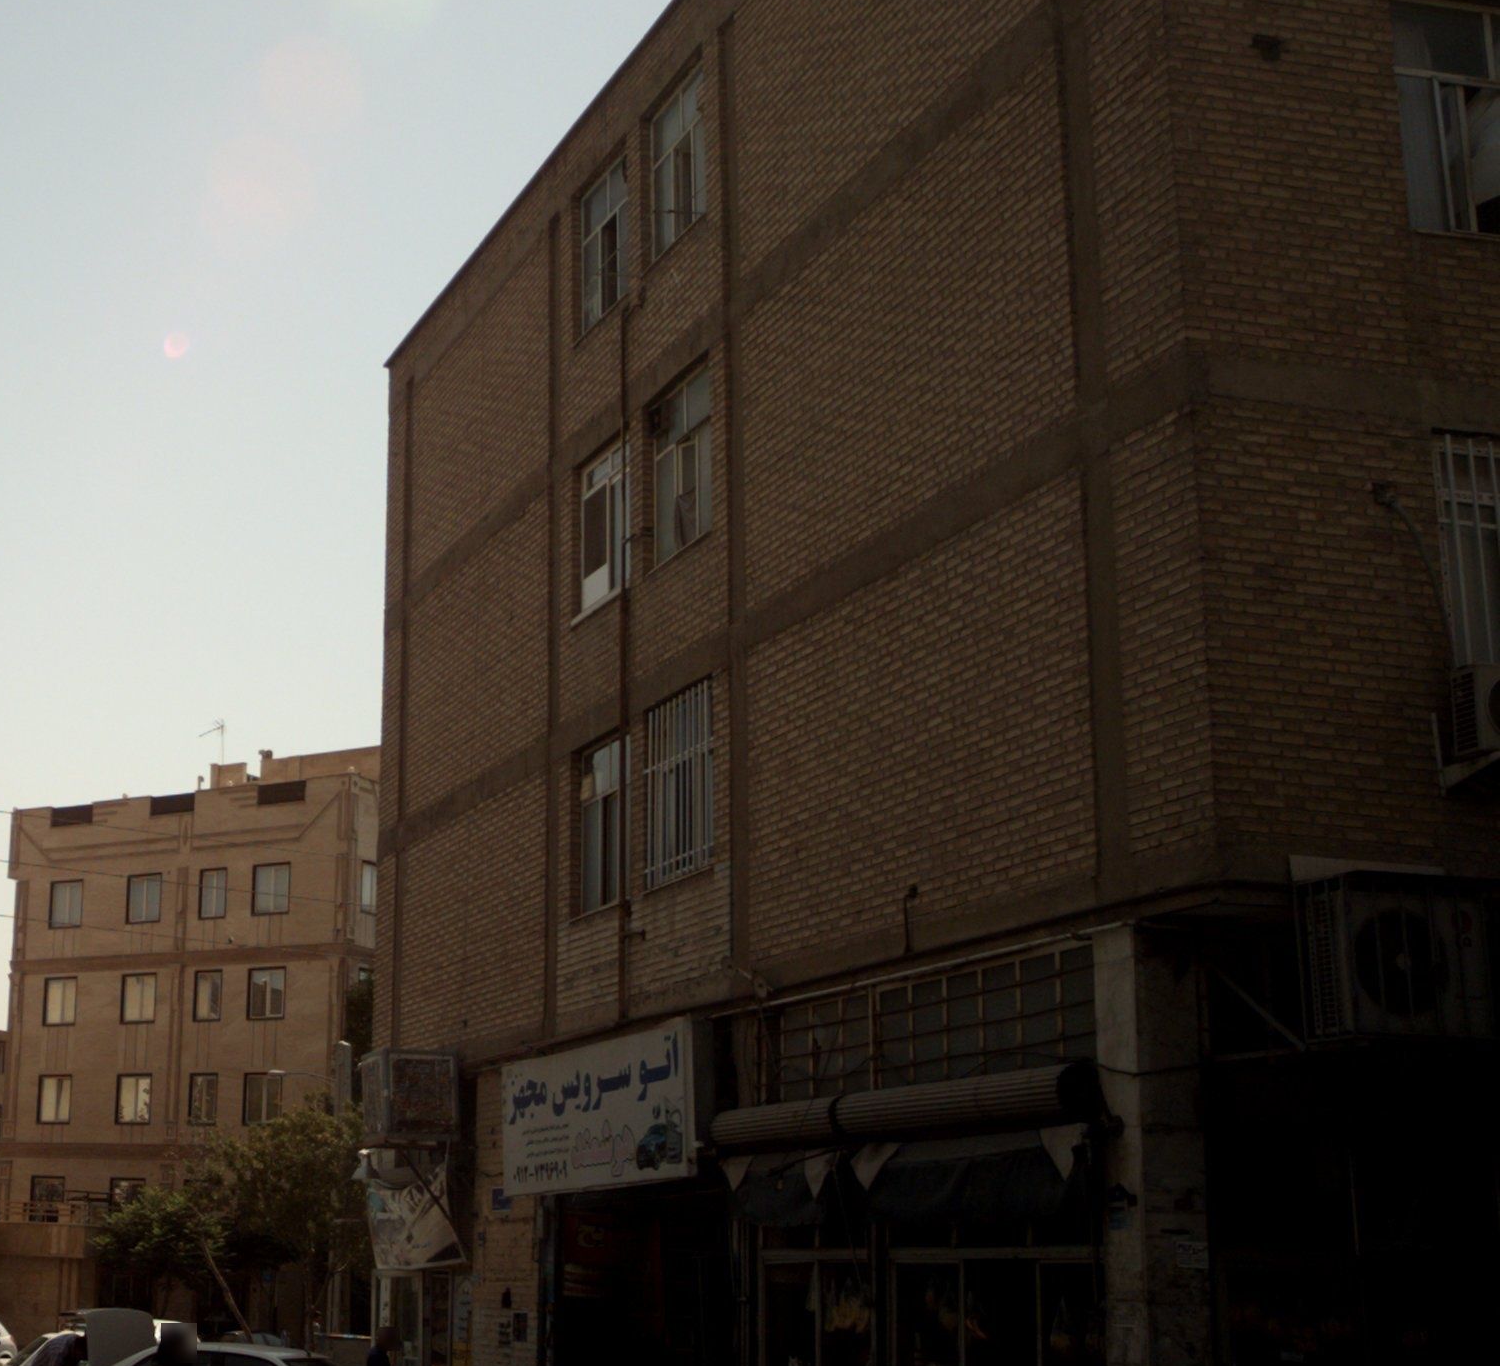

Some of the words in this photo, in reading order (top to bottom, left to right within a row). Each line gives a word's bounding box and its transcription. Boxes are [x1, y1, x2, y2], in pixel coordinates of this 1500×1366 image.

[552, 1061, 631, 1117] سرویس
[636, 1030, 679, 1101] اتو
[508, 1078, 548, 1125] مجهز
